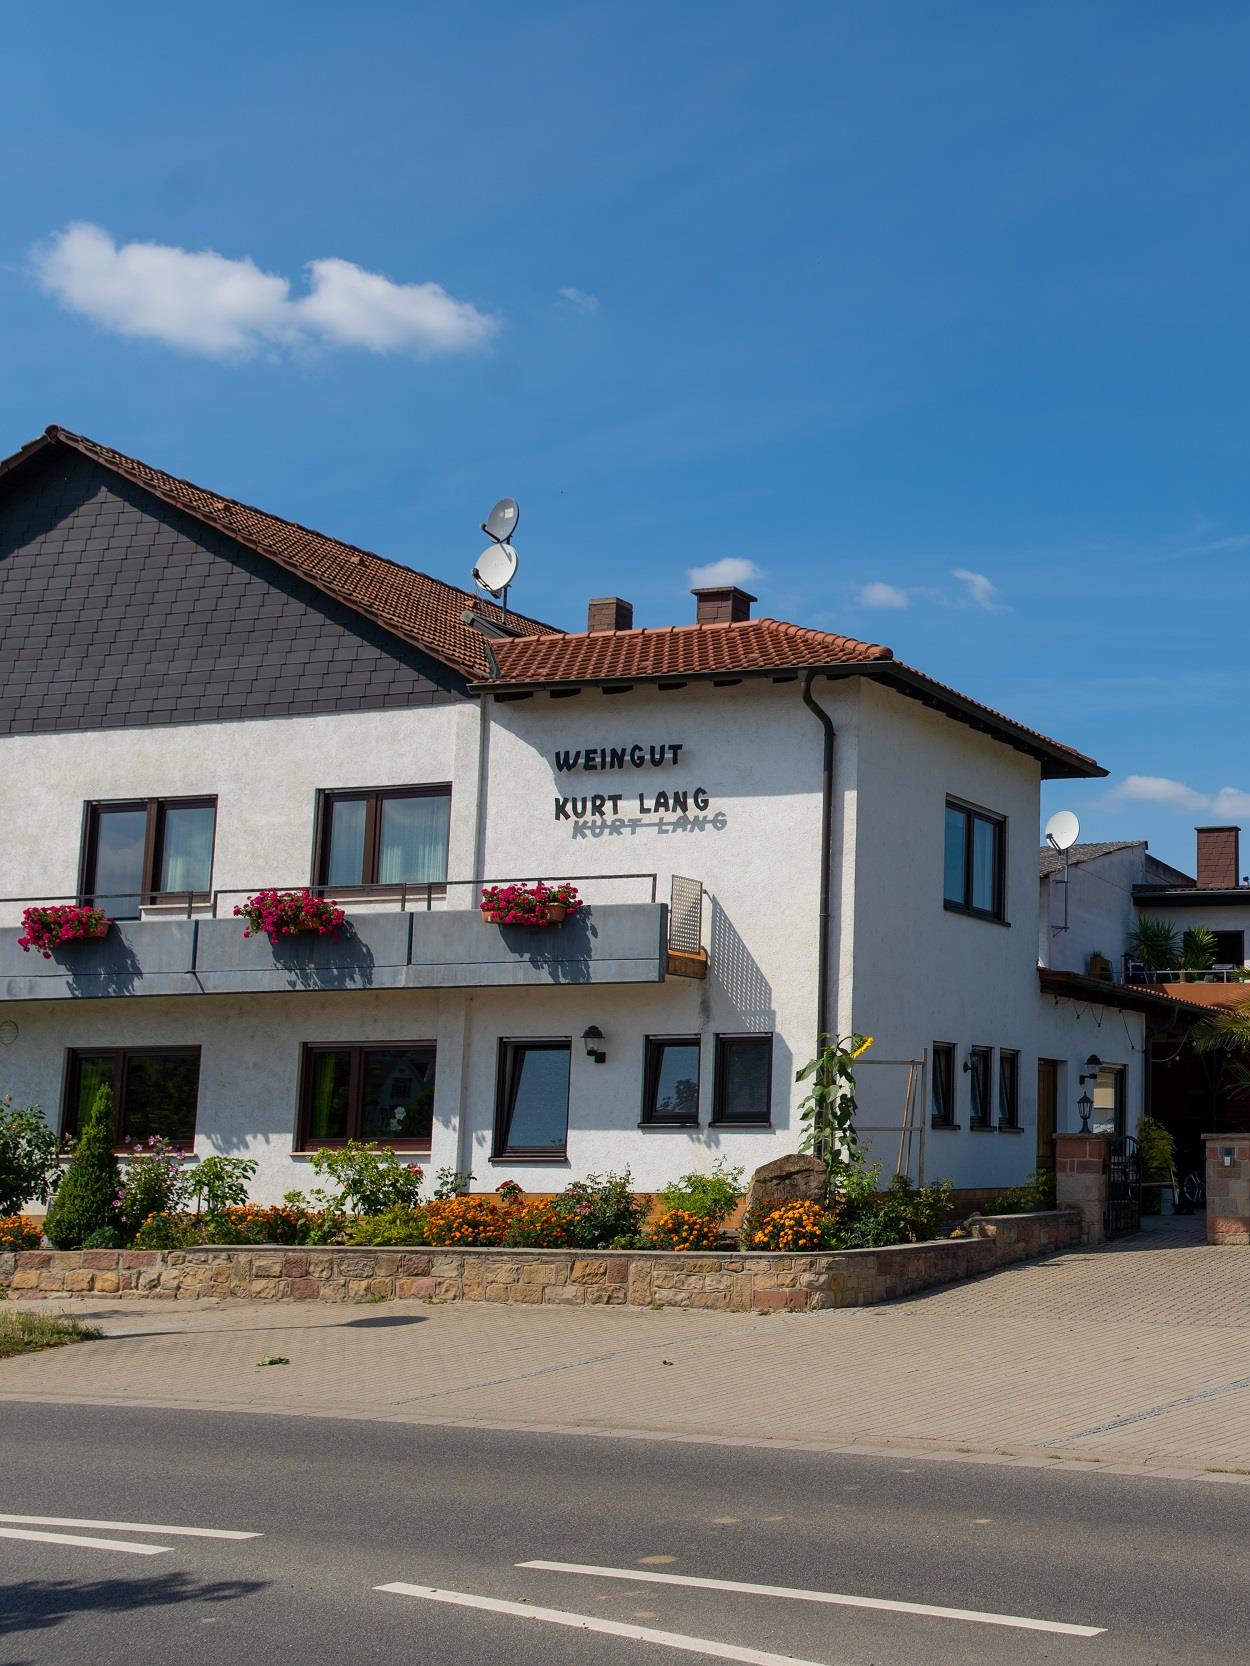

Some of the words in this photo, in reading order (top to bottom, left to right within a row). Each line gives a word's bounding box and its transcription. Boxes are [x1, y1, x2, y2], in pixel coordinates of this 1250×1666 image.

[554, 744, 683, 773] WEINGUT
[554, 793, 623, 821] KURT
[638, 787, 709, 815] LANG
